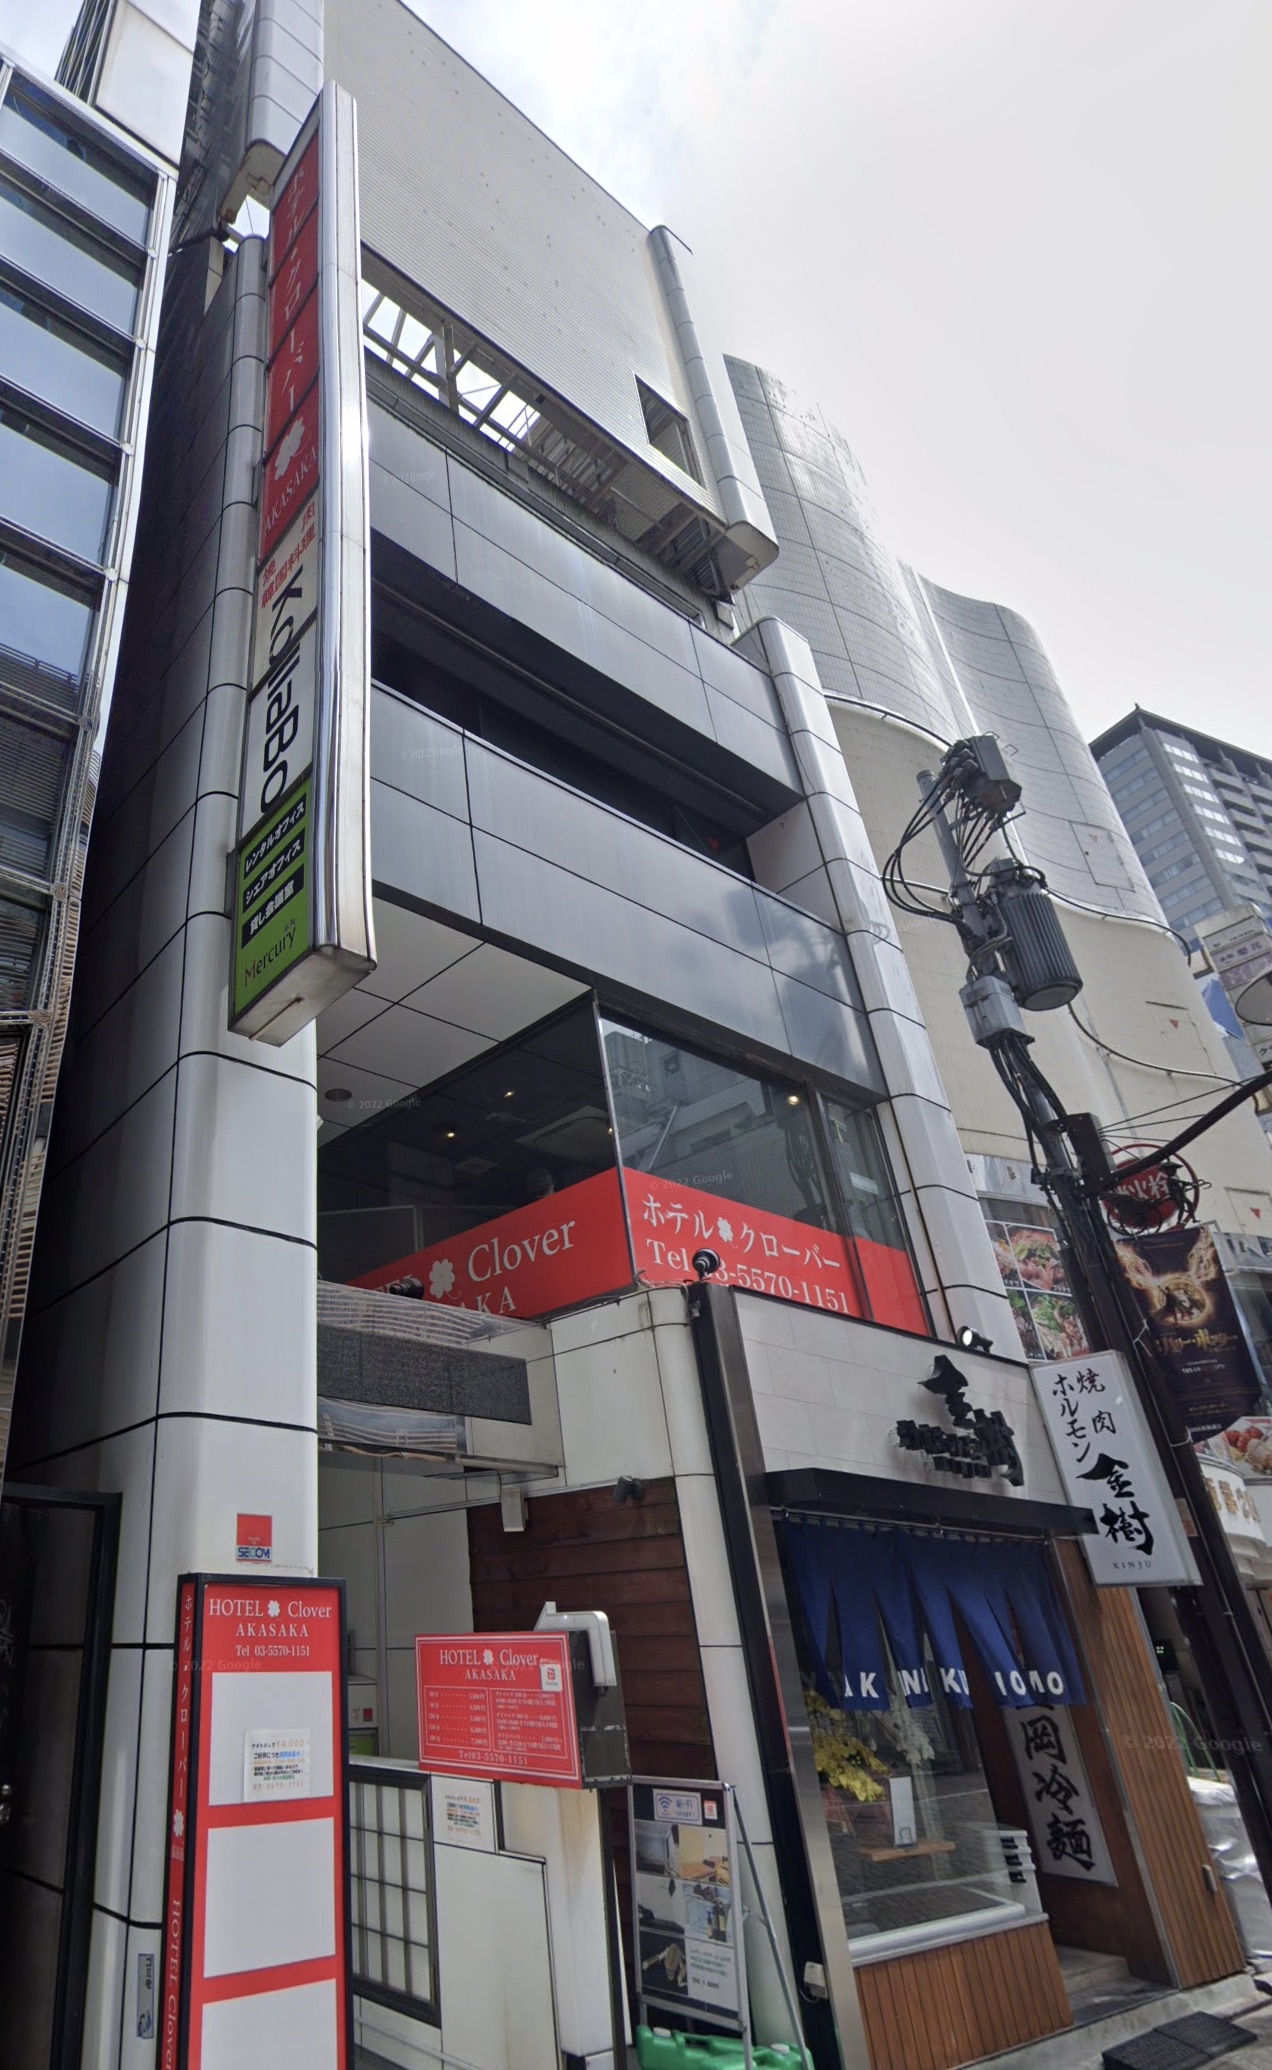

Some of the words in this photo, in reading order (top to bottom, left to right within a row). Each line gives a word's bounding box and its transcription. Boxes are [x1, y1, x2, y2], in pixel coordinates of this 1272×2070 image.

[259, 447, 317, 537] AKASAKA
[245, 801, 305, 872] レンタルオフィス
[245, 838, 301, 904] シェアオフィス
[250, 880, 294, 935] 貸し会議室
[244, 927, 296, 987] Mercury
[467, 1217, 577, 1285] Clover
[643, 1193, 715, 1240] ホテル
[740, 1221, 842, 1269] クローバー
[646, 1238, 690, 1272] Tel
[704, 1257, 850, 1314] 3-5570-1151
[1052, 1373, 1091, 1463] ホルモン
[1077, 1368, 1117, 1434] 焼肉
[1075, 1452, 1155, 1556] 金樹
[238, 1546, 270, 1559] SECOM
[208, 1599, 264, 1617] HOTEL
[288, 1600, 332, 1619] Clover
[235, 1622, 310, 1638] AKASAKA
[235, 1644, 250, 1656] Tel
[254, 1645, 311, 1657] 03-5570-1151
[440, 1649, 482, 1666] HOTEL
[499, 1649, 538, 1666] Clover
[464, 1668, 517, 1682] AKASAKA
[1015, 1703, 1096, 1872] 岡冷麺
[168, 1899, 181, 1989] HOTEL
